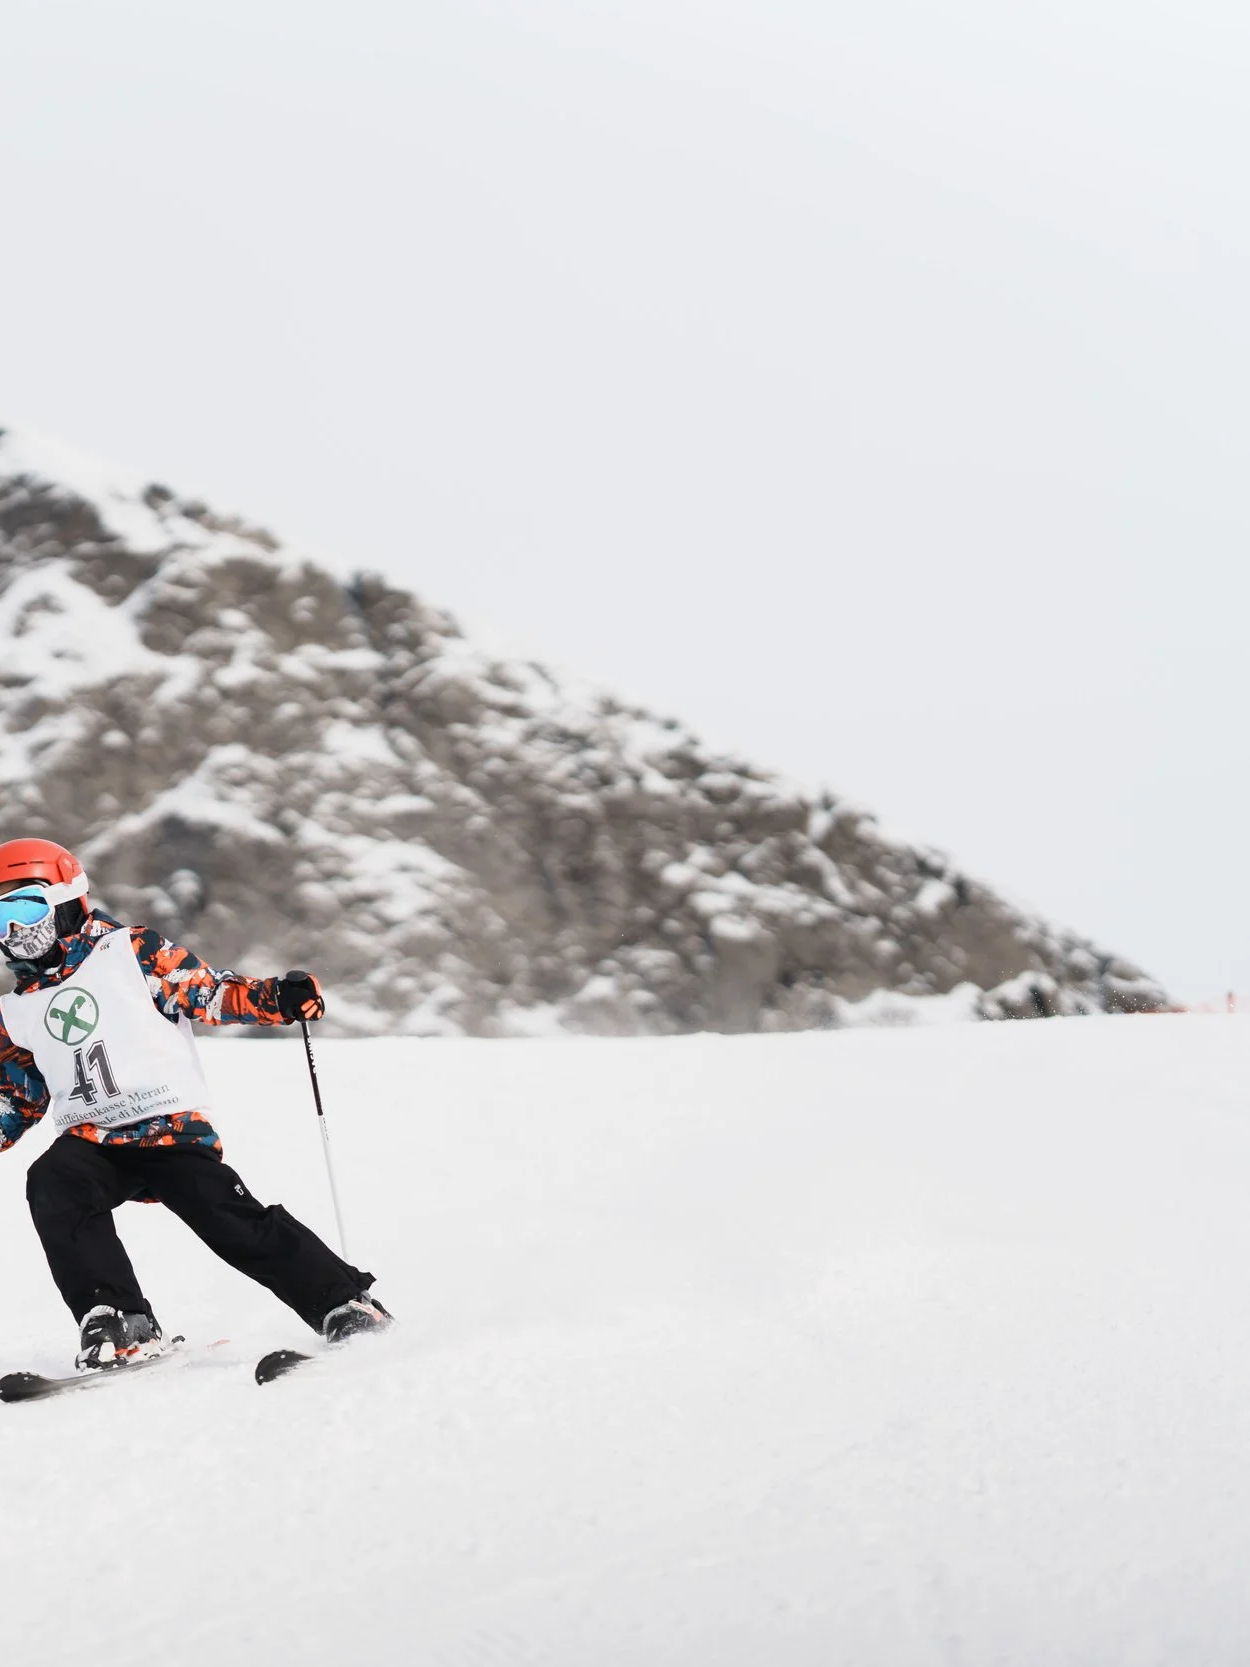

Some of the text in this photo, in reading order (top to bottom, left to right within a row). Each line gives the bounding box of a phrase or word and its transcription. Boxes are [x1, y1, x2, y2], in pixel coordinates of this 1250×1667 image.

[68, 1039, 121, 1107] 41
[54, 1084, 170, 1127] aiffeisenkasse Meran
[118, 1109, 131, 1119] di
